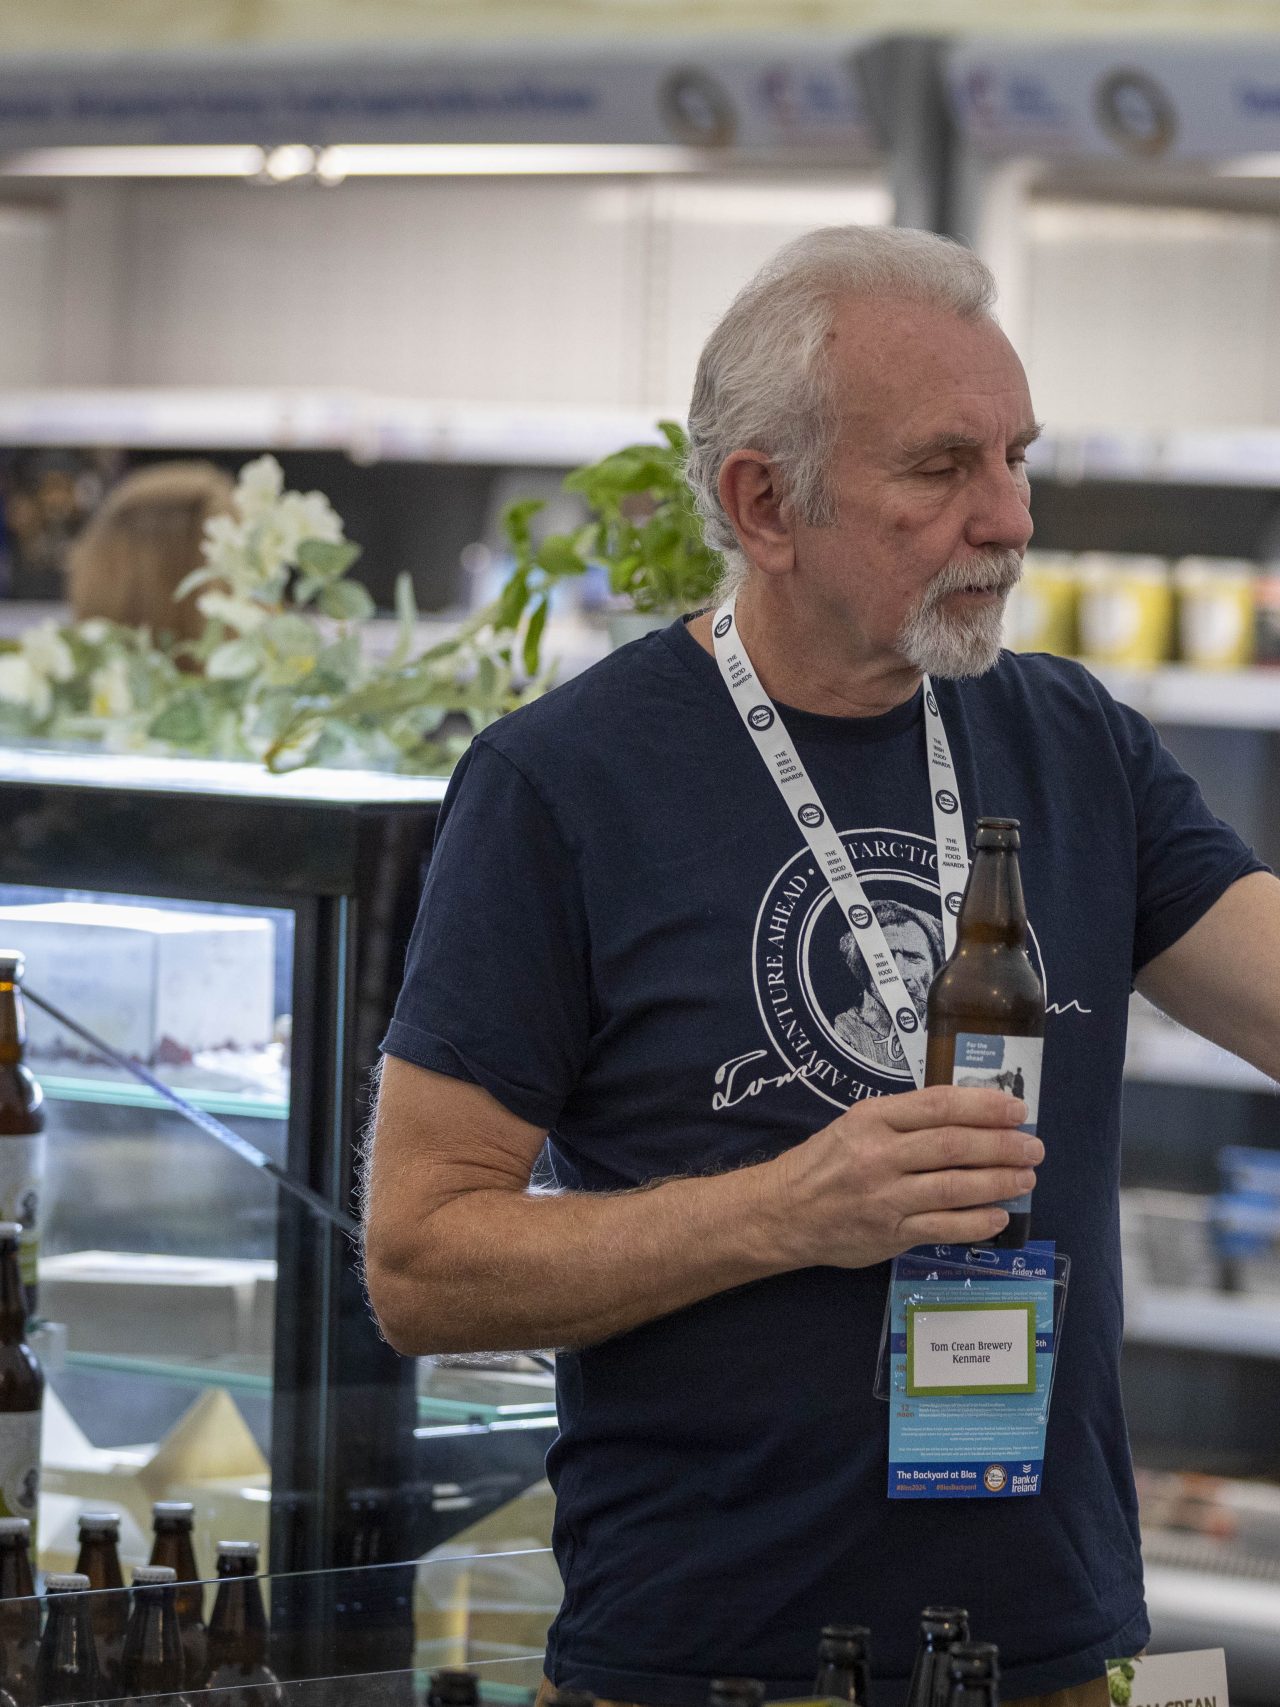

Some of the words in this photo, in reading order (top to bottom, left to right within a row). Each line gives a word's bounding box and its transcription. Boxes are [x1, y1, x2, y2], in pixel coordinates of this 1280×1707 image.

[727, 654, 737, 663] THE
[728, 661, 742, 673] IRISH
[731, 667, 746, 680] FOOD
[732, 673, 752, 688] AWARDS
[774, 750, 787, 759] THE
[933, 752, 947, 761] FOOD
[777, 758, 792, 767] IRISH
[780, 765, 797, 775] FOOD
[780, 772, 804, 784] AWARDS
[827, 858, 841, 866] IRISH
[942, 861, 965, 869] AWARDS
[830, 865, 846, 874] FOOD
[831, 872, 853, 881] AWARDS
[767, 874, 808, 949] AHEAD
[876, 960, 889, 968] IRISH
[878, 968, 893, 976] FOOD
[879, 975, 899, 985] AWARDS
[766, 954, 848, 1088] ADVENTURE
[848, 1080, 894, 1100] HE
[1012, 1268, 1034, 1277] Friday
[930, 1342, 948, 1352] Tom
[951, 1341, 976, 1351] Crean
[978, 1340, 1013, 1352] Brewery
[952, 1354, 991, 1363] Kenmare
[896, 1471, 912, 1479] The
[913, 1470, 949, 1481] Backyard
[951, 1471, 959, 1479] at
[960, 1470, 977, 1479] Blas
[1012, 1476, 1030, 1485] Bank
[1031, 1474, 1040, 1484] of
[936, 1484, 977, 1492] #BlasBackyard
[1012, 1483, 1037, 1493] Ireland
[1165, 1696, 1216, 1707] EAN
